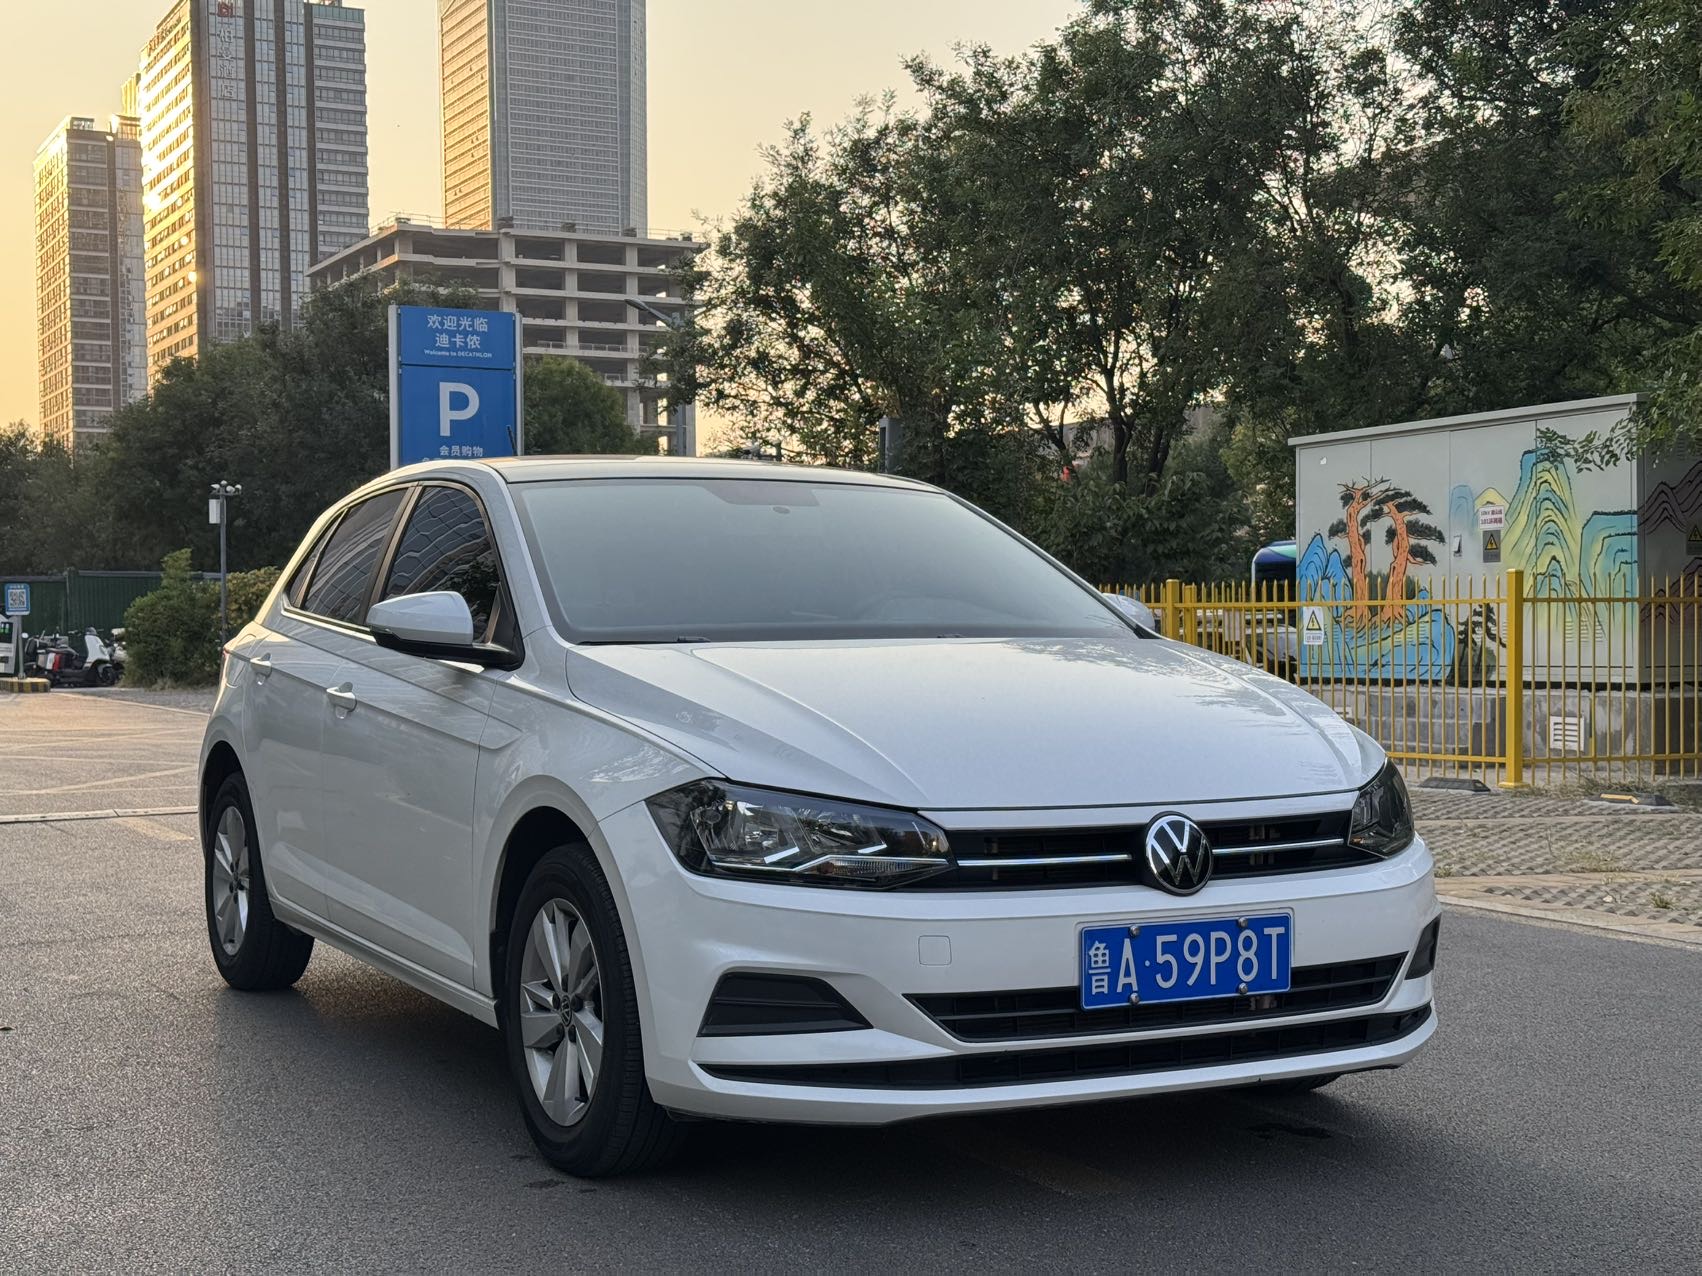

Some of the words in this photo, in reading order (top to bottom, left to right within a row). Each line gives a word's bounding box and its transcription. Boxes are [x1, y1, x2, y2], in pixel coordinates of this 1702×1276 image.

[427, 314, 489, 333] 欢迎光临
[435, 333, 481, 349] 迪卡侬
[439, 381, 480, 437] P
[439, 445, 484, 457] 会员购物
